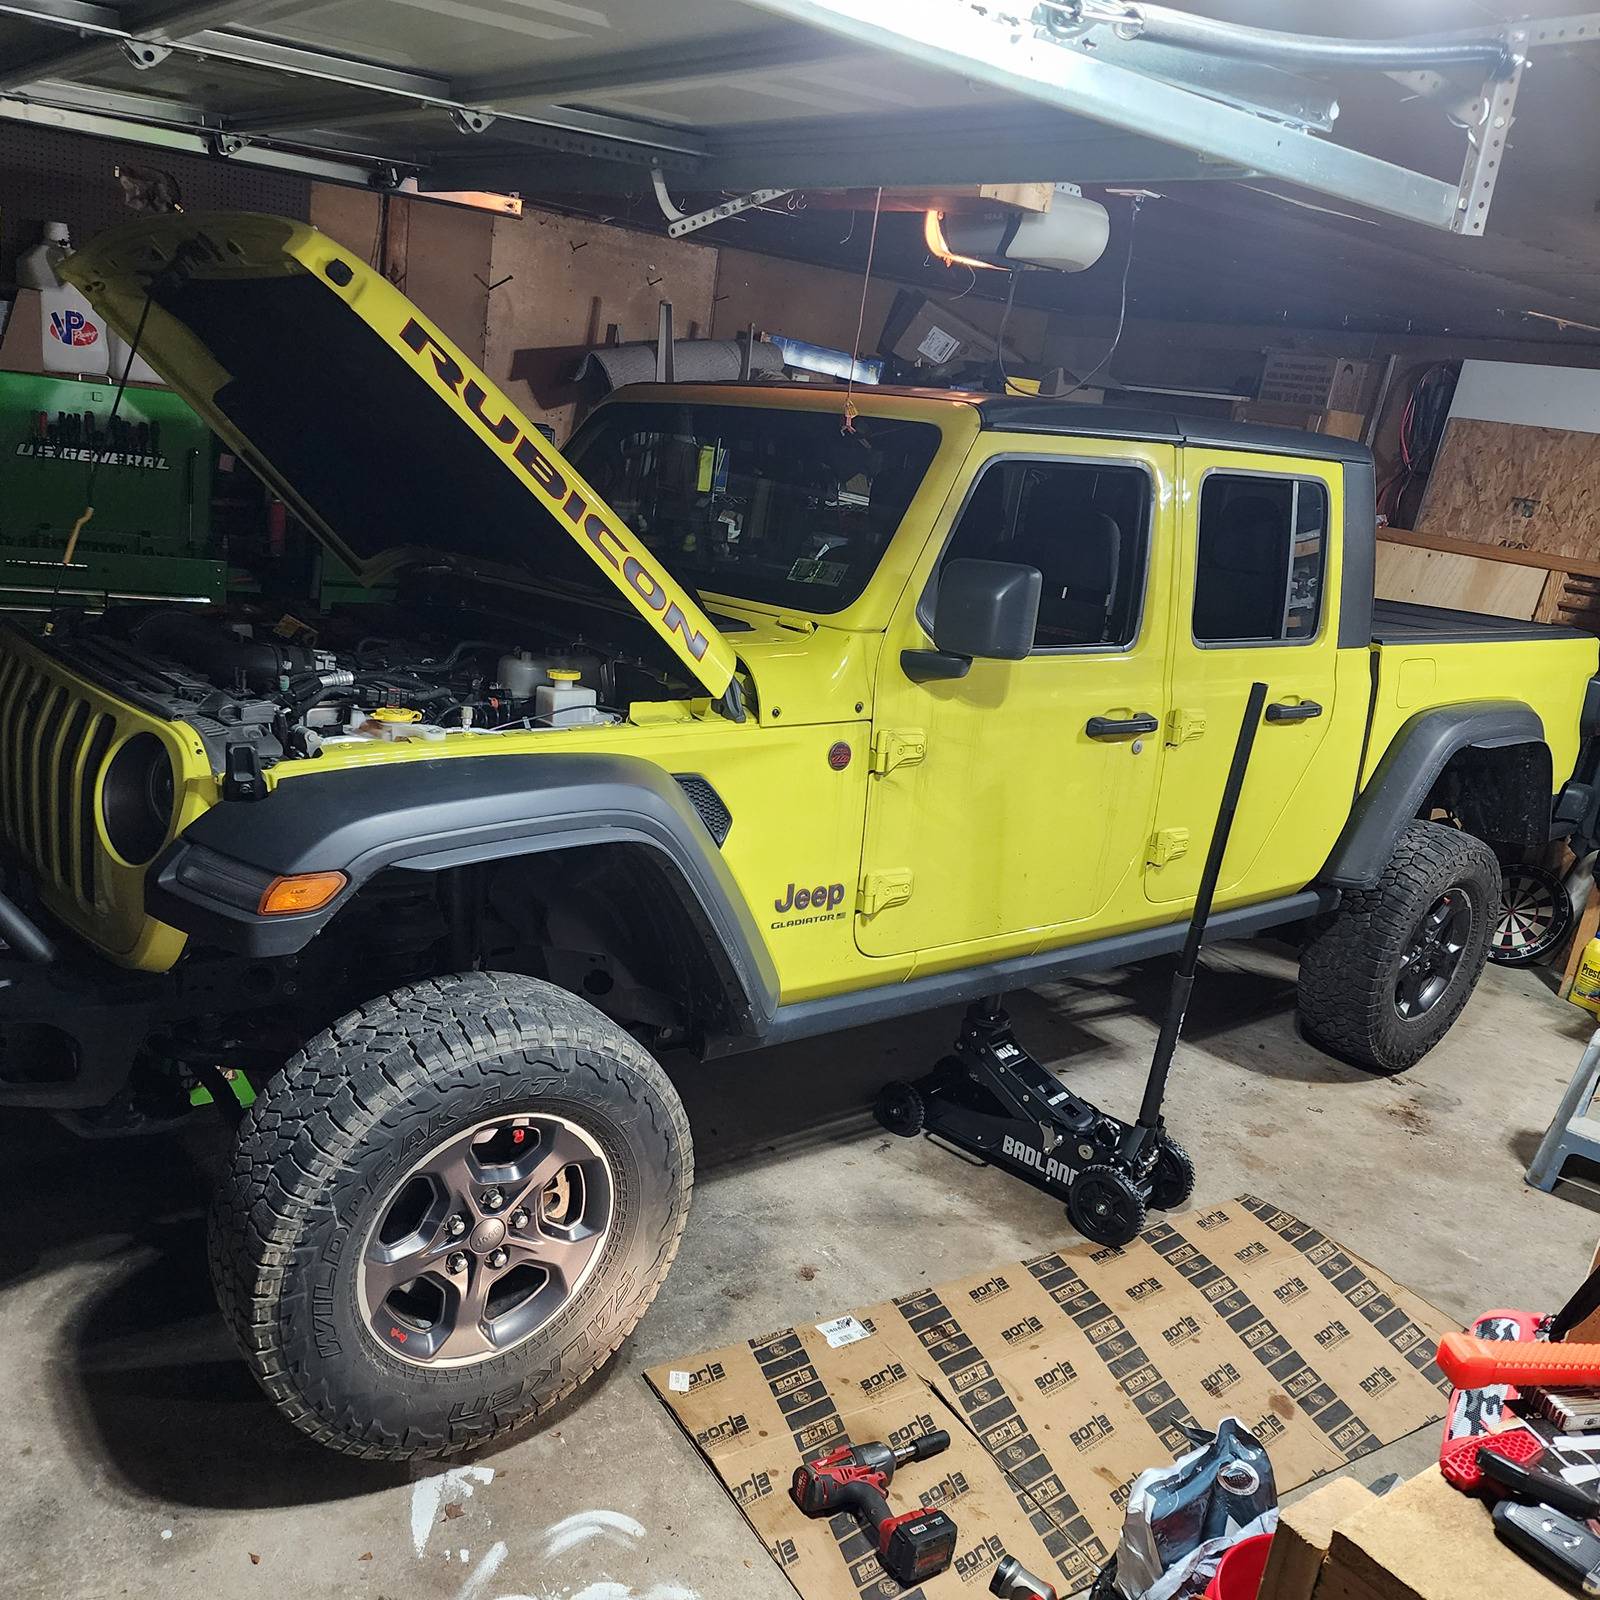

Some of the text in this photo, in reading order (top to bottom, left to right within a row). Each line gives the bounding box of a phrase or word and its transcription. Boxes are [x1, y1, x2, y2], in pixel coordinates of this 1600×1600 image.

[51, 310, 84, 345] VP
[399, 317, 709, 662] RUBICON
[774, 883, 845, 914] Jeep
[771, 914, 835, 930] GLADIATOR
[689, 1363, 726, 1385] orla
[1252, 1414, 1286, 1439] orla
[961, 1557, 994, 1583] EXHAUST
